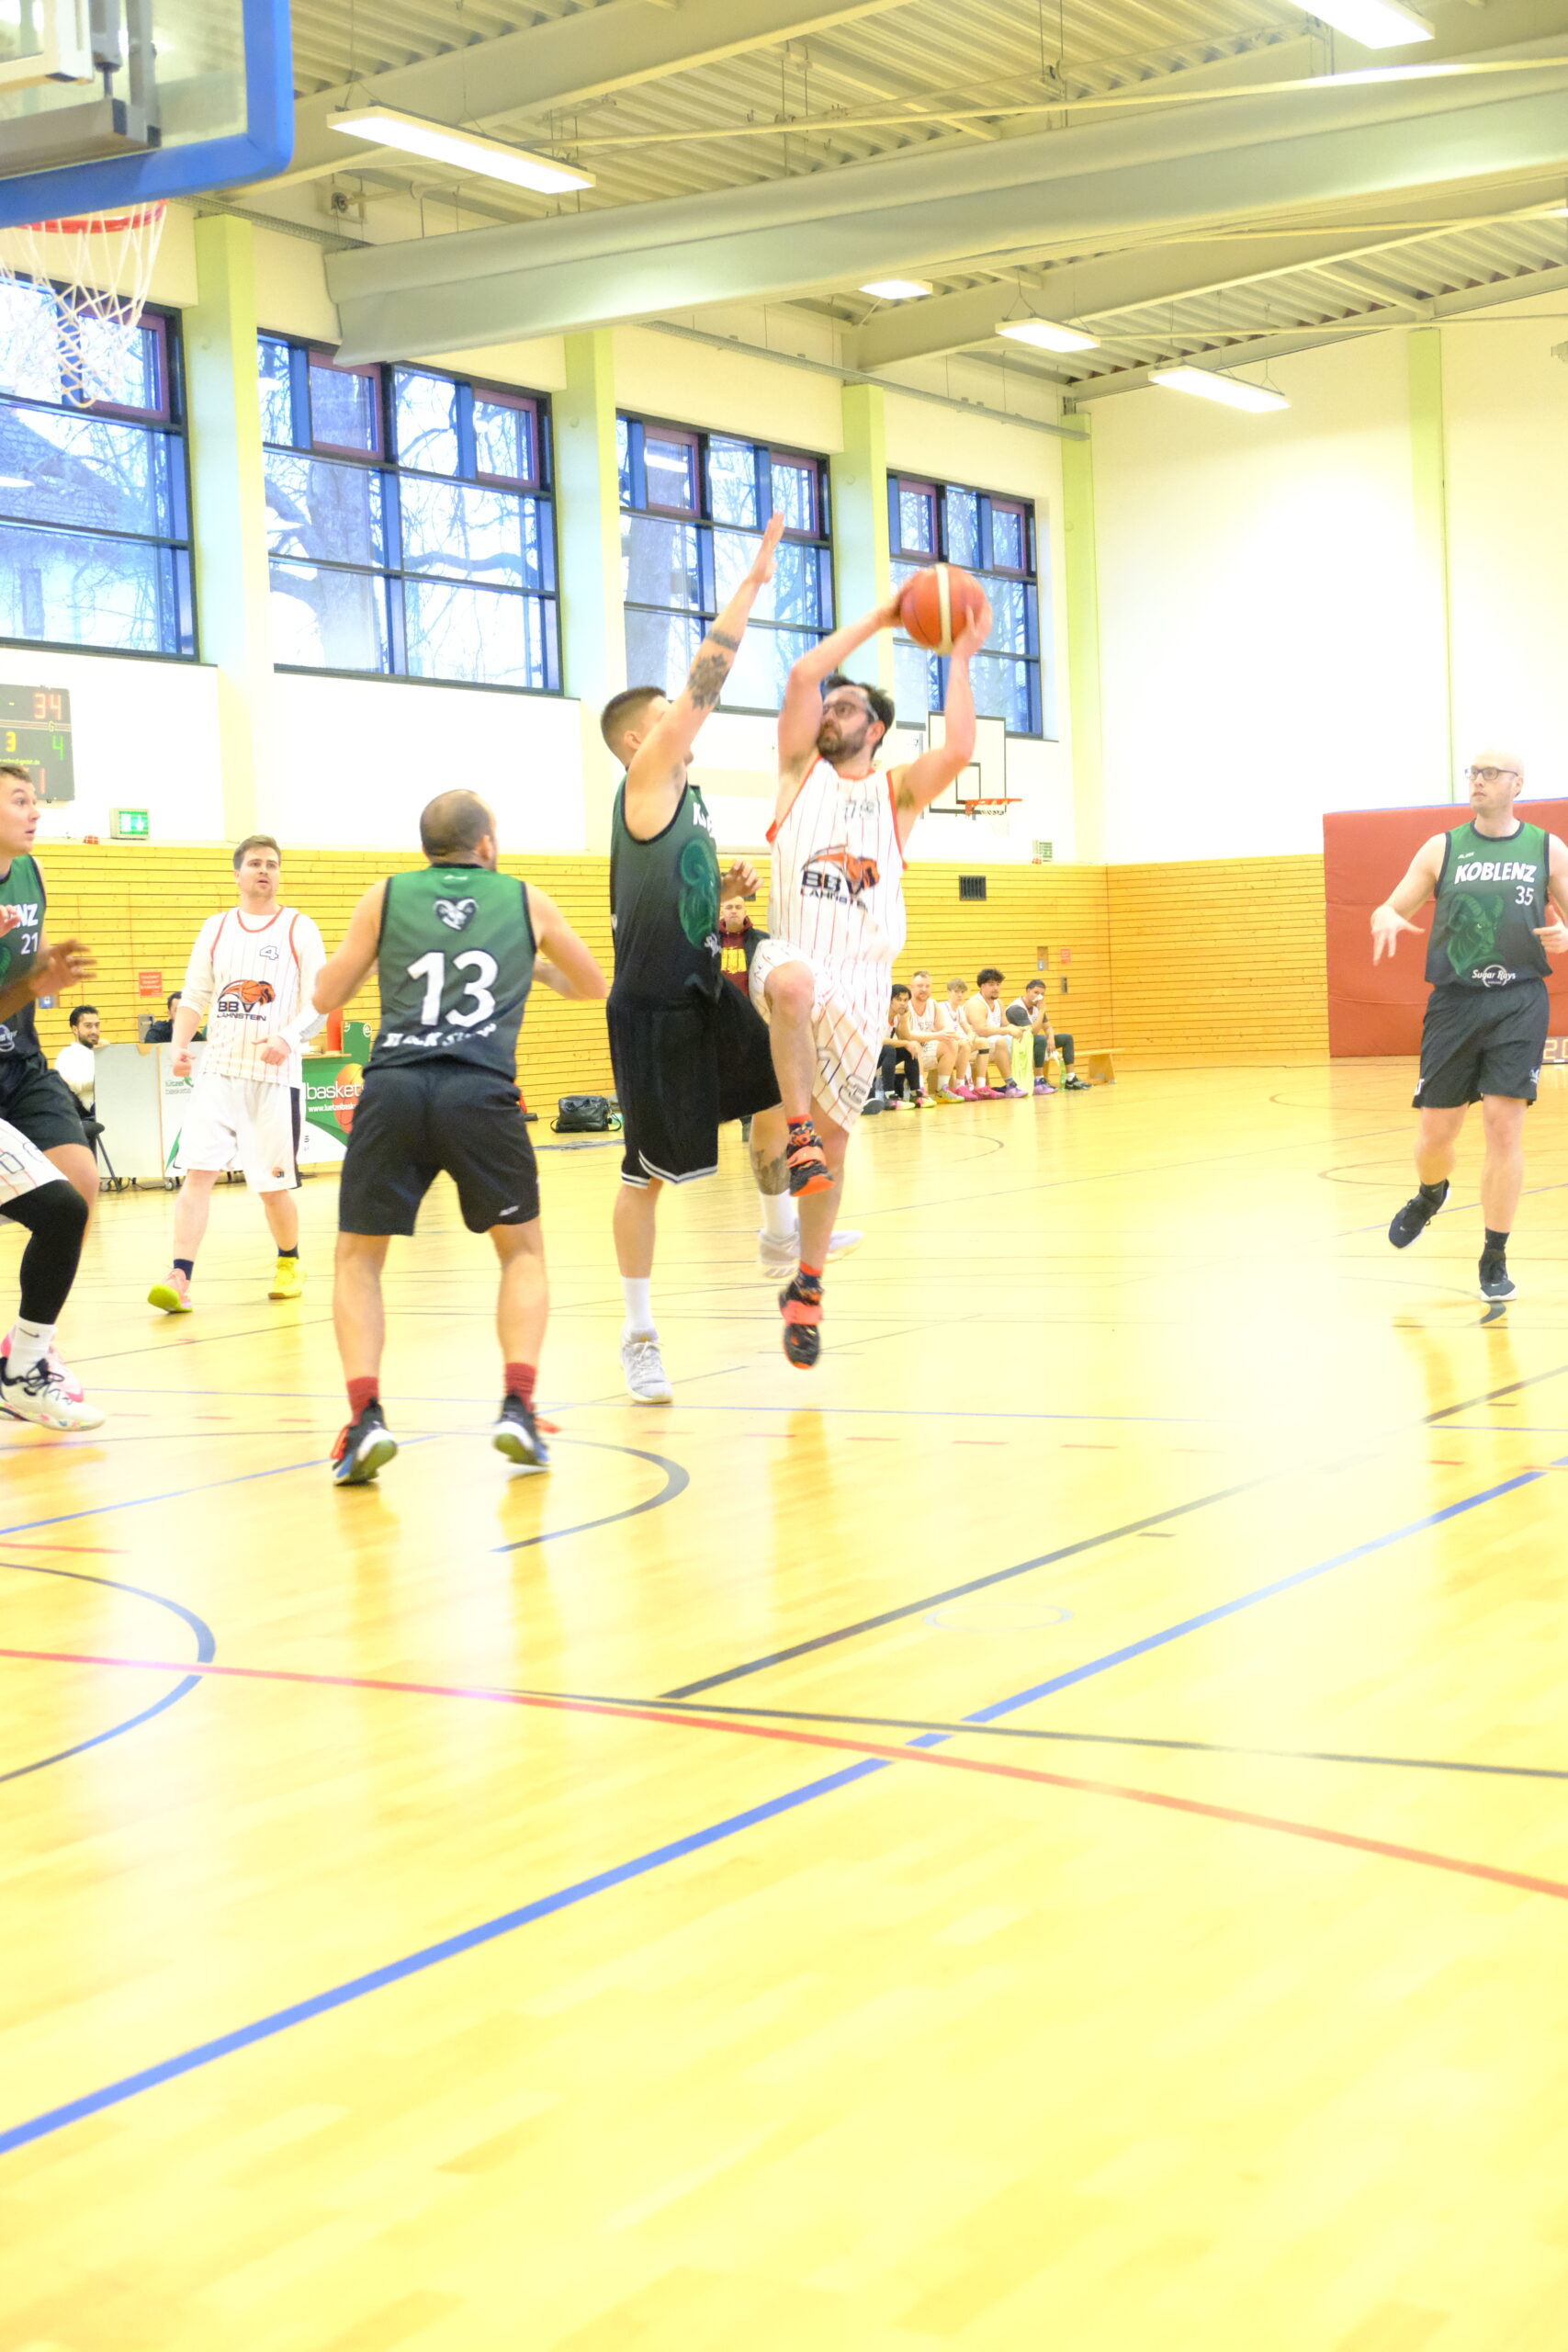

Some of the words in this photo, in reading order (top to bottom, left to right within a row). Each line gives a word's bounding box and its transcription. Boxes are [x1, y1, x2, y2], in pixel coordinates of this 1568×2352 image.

[33, 693, 62, 721] 34
[52, 734, 64, 761] 4
[1454, 861, 1538, 885] KOBLENZ
[1515, 885, 1535, 906] 35
[21, 932, 39, 956] 21
[259, 944, 279, 961] 4
[1472, 969, 1496, 980] Sugar
[407, 950, 498, 1027] 13
